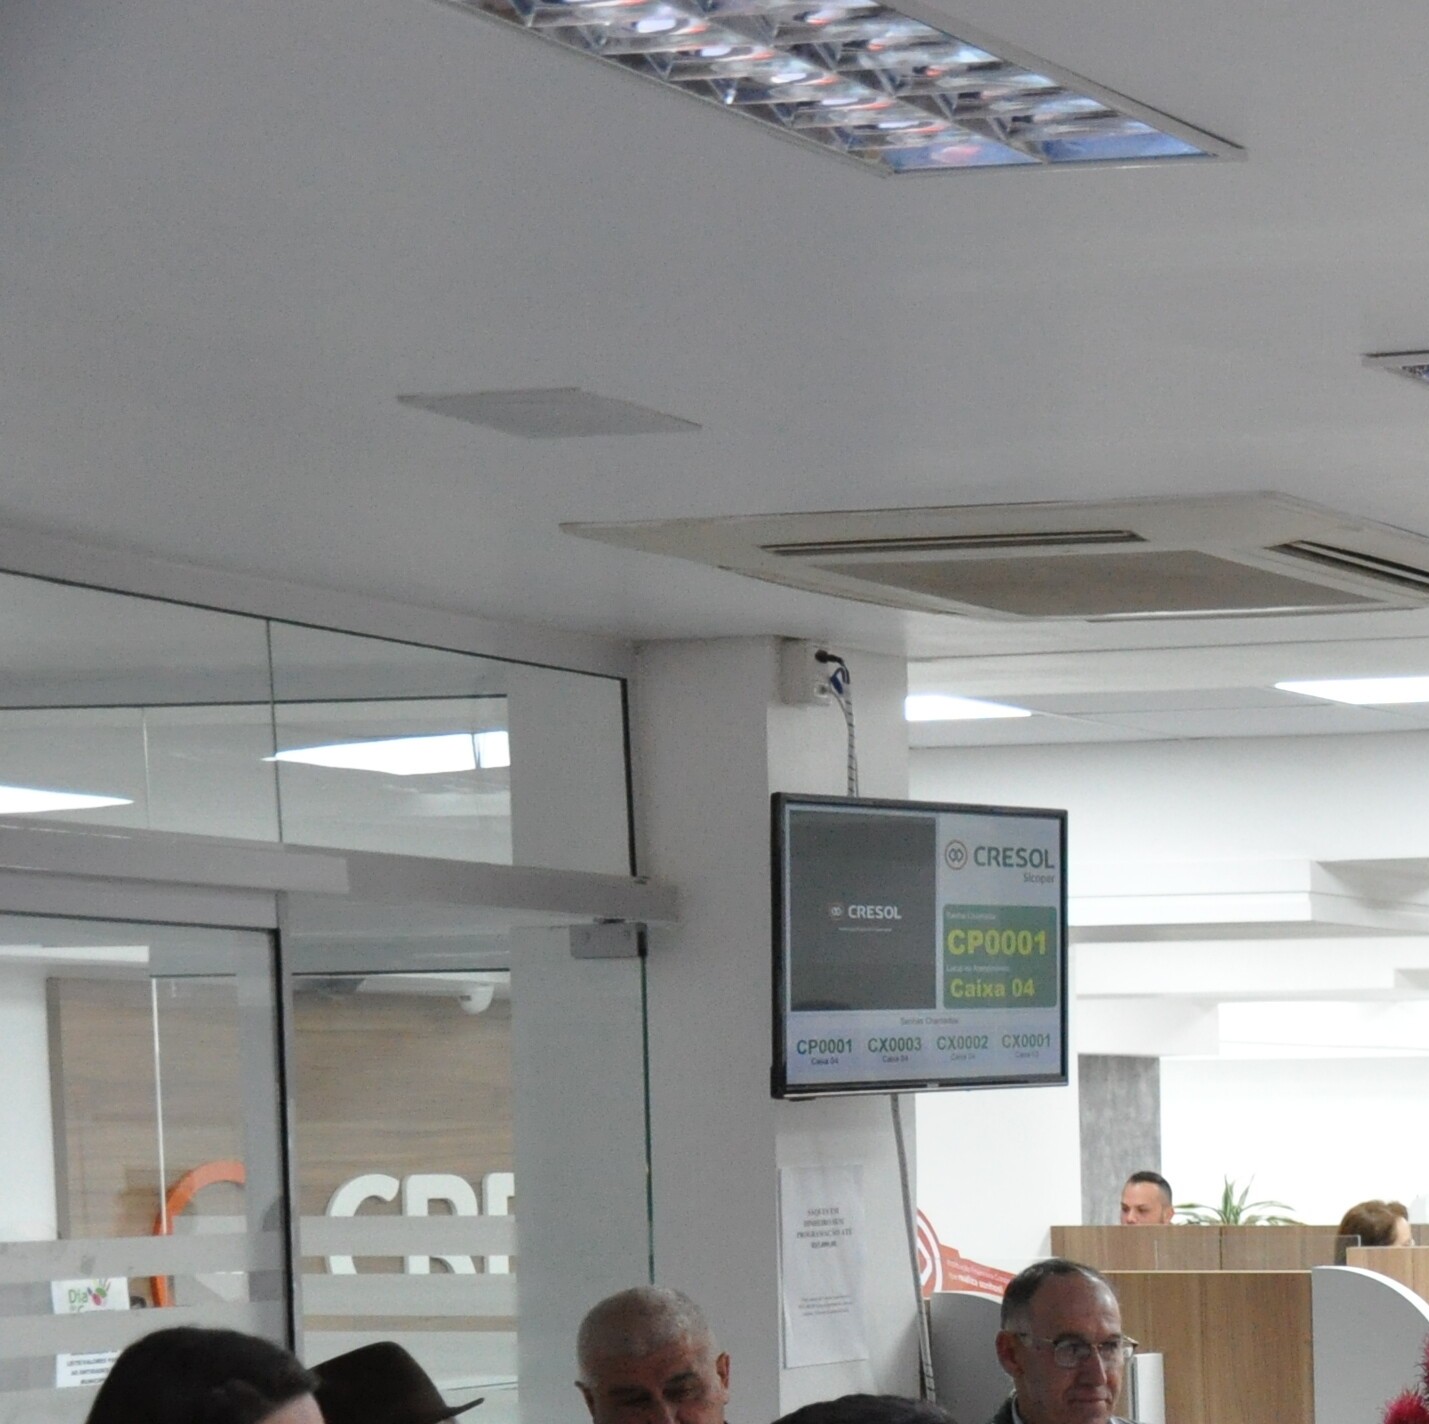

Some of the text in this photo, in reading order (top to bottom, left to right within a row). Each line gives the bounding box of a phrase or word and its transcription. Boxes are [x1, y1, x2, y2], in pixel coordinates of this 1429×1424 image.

[973, 845, 1056, 869] CRESOL
[848, 904, 902, 920] CRESOL
[947, 929, 1047, 955] CP0001
[950, 978, 1035, 998] Caixa 04
[796, 1038, 853, 1055] CP0001
[867, 1037, 922, 1053] CX0003
[936, 1035, 989, 1050] CX0002
[1001, 1033, 1051, 1048] CX0001
